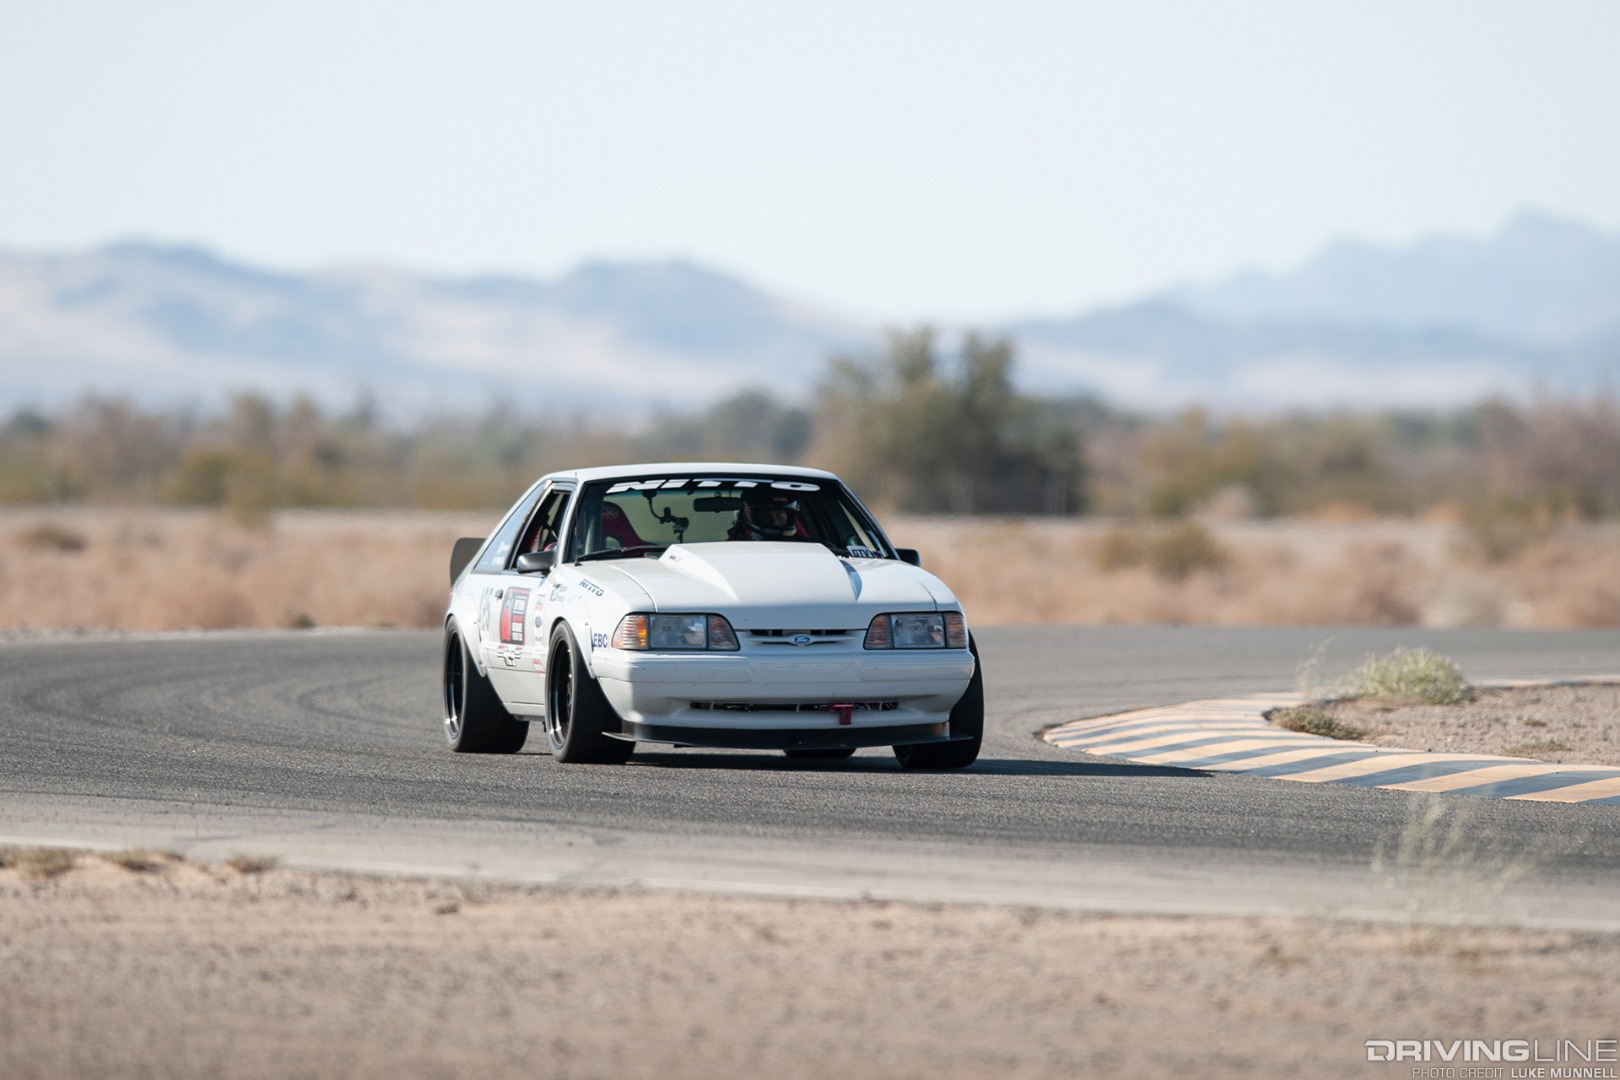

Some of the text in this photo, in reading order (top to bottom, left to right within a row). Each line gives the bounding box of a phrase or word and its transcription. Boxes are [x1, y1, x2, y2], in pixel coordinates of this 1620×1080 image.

[606, 478, 821, 494] NITTO
[579, 579, 605, 597] NITTO
[593, 633, 608, 648] EBC
